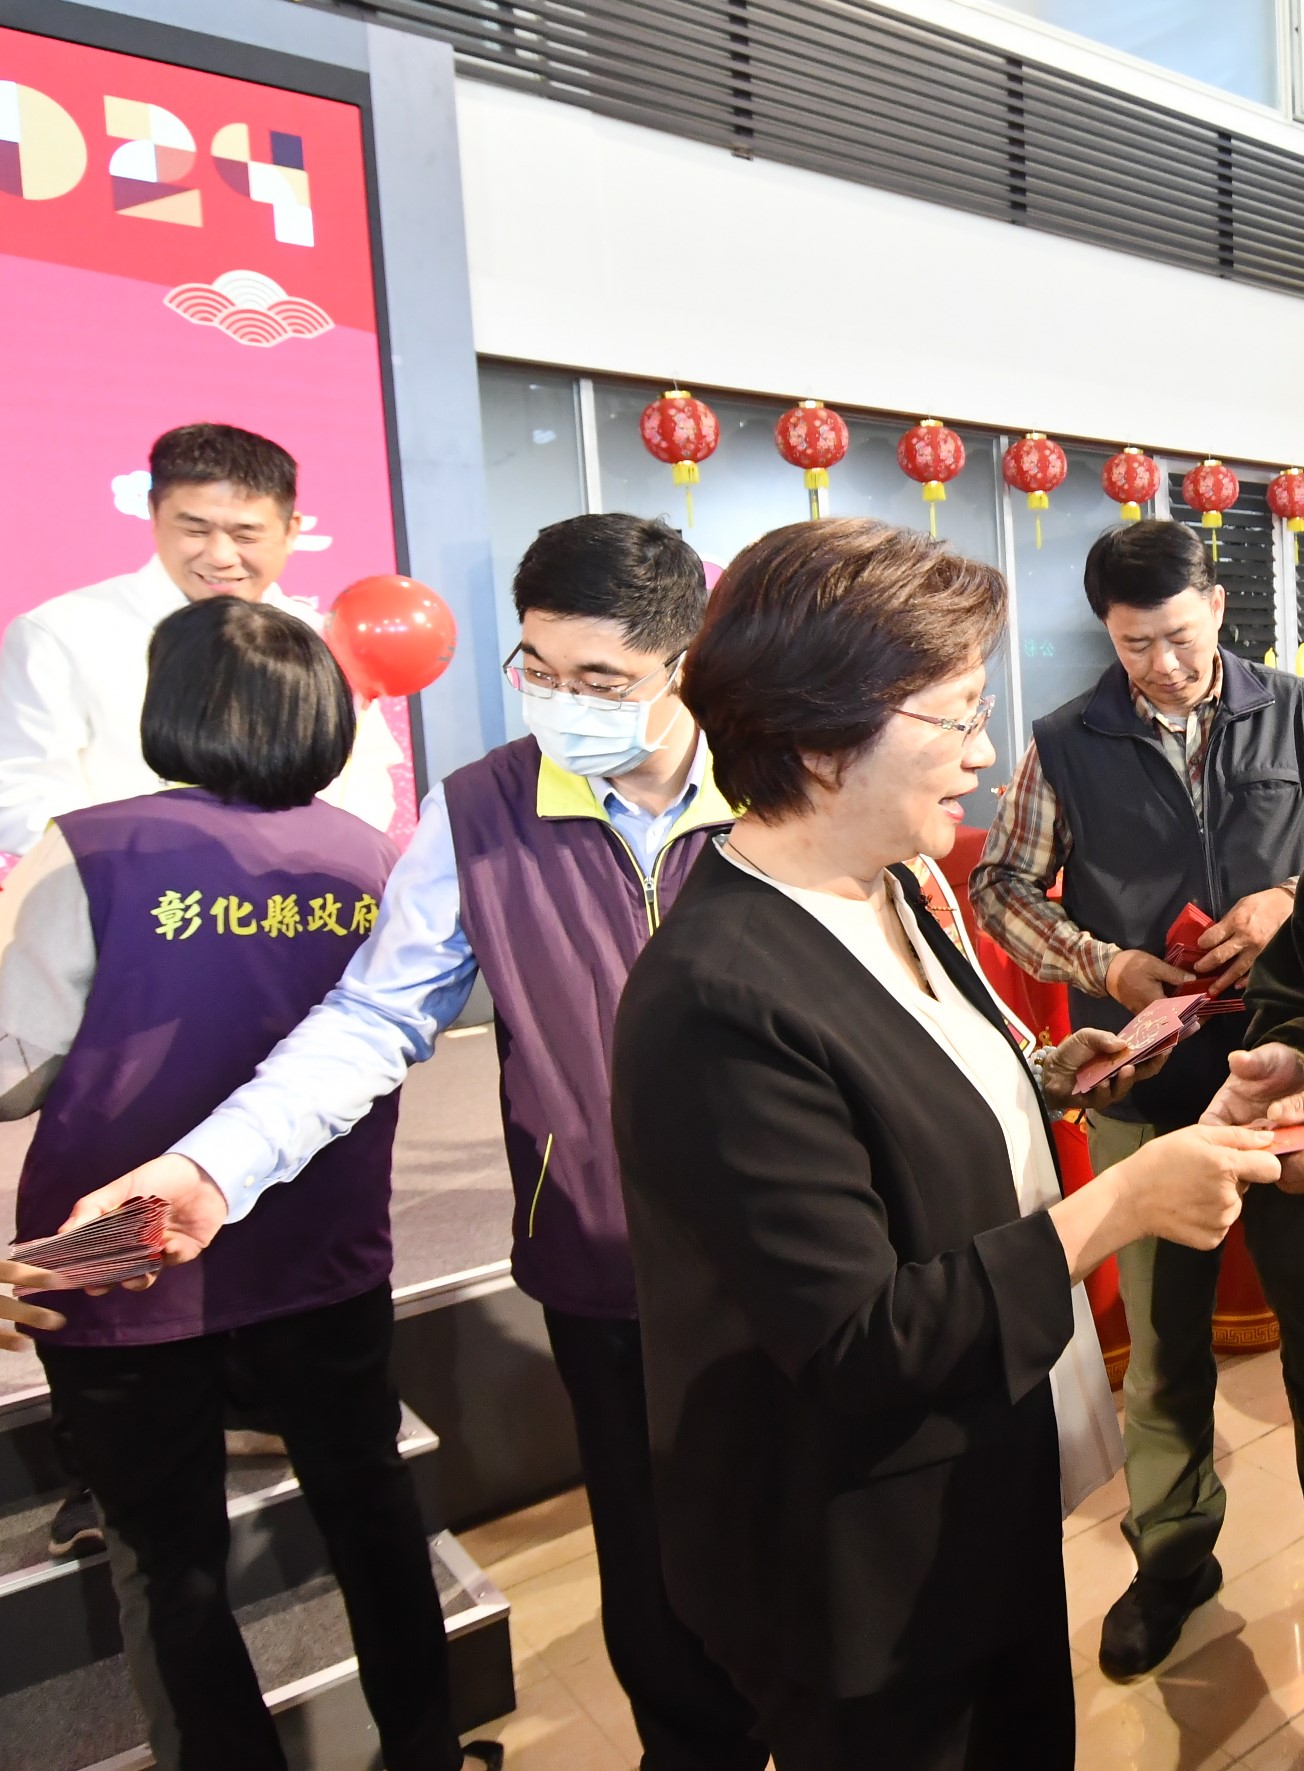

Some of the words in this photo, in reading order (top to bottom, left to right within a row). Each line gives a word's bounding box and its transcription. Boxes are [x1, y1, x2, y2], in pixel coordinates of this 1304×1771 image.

[150, 889, 379, 941] 彰化縣政府
